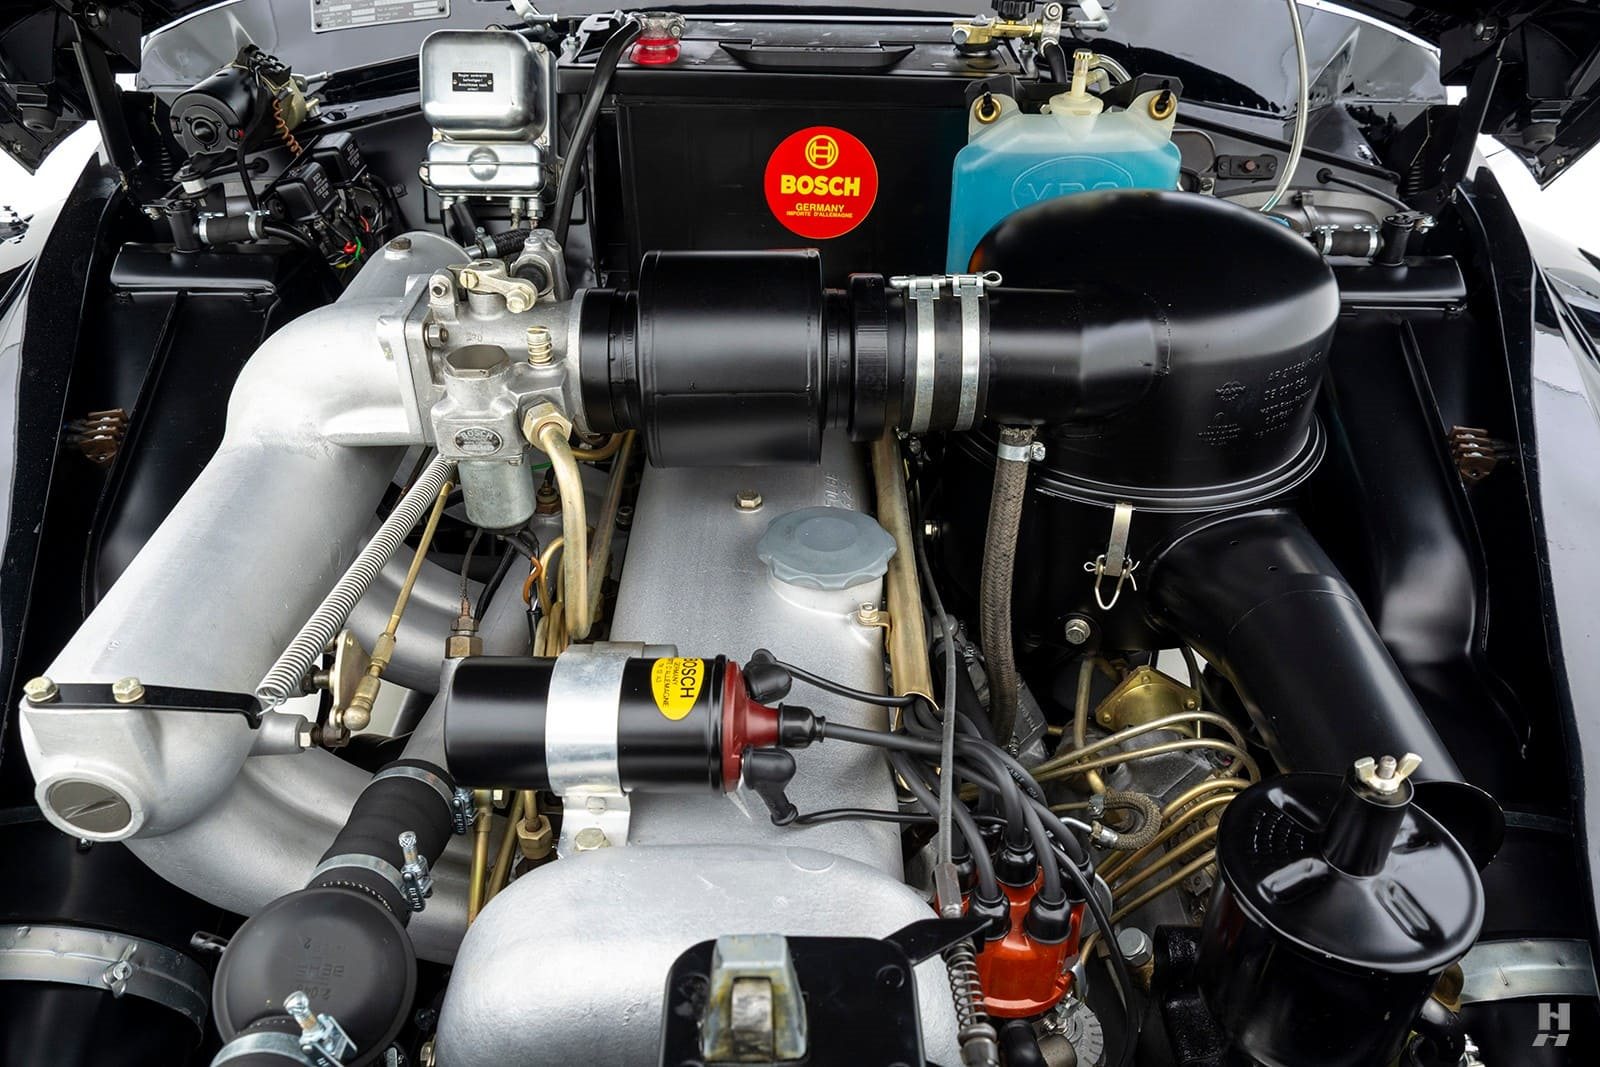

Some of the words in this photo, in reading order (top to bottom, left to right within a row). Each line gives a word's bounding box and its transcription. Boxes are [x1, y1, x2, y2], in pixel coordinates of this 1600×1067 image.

[780, 174, 861, 197] BOSCH
[795, 203, 845, 212] GERMANY
[460, 429, 493, 439] BOSCH
